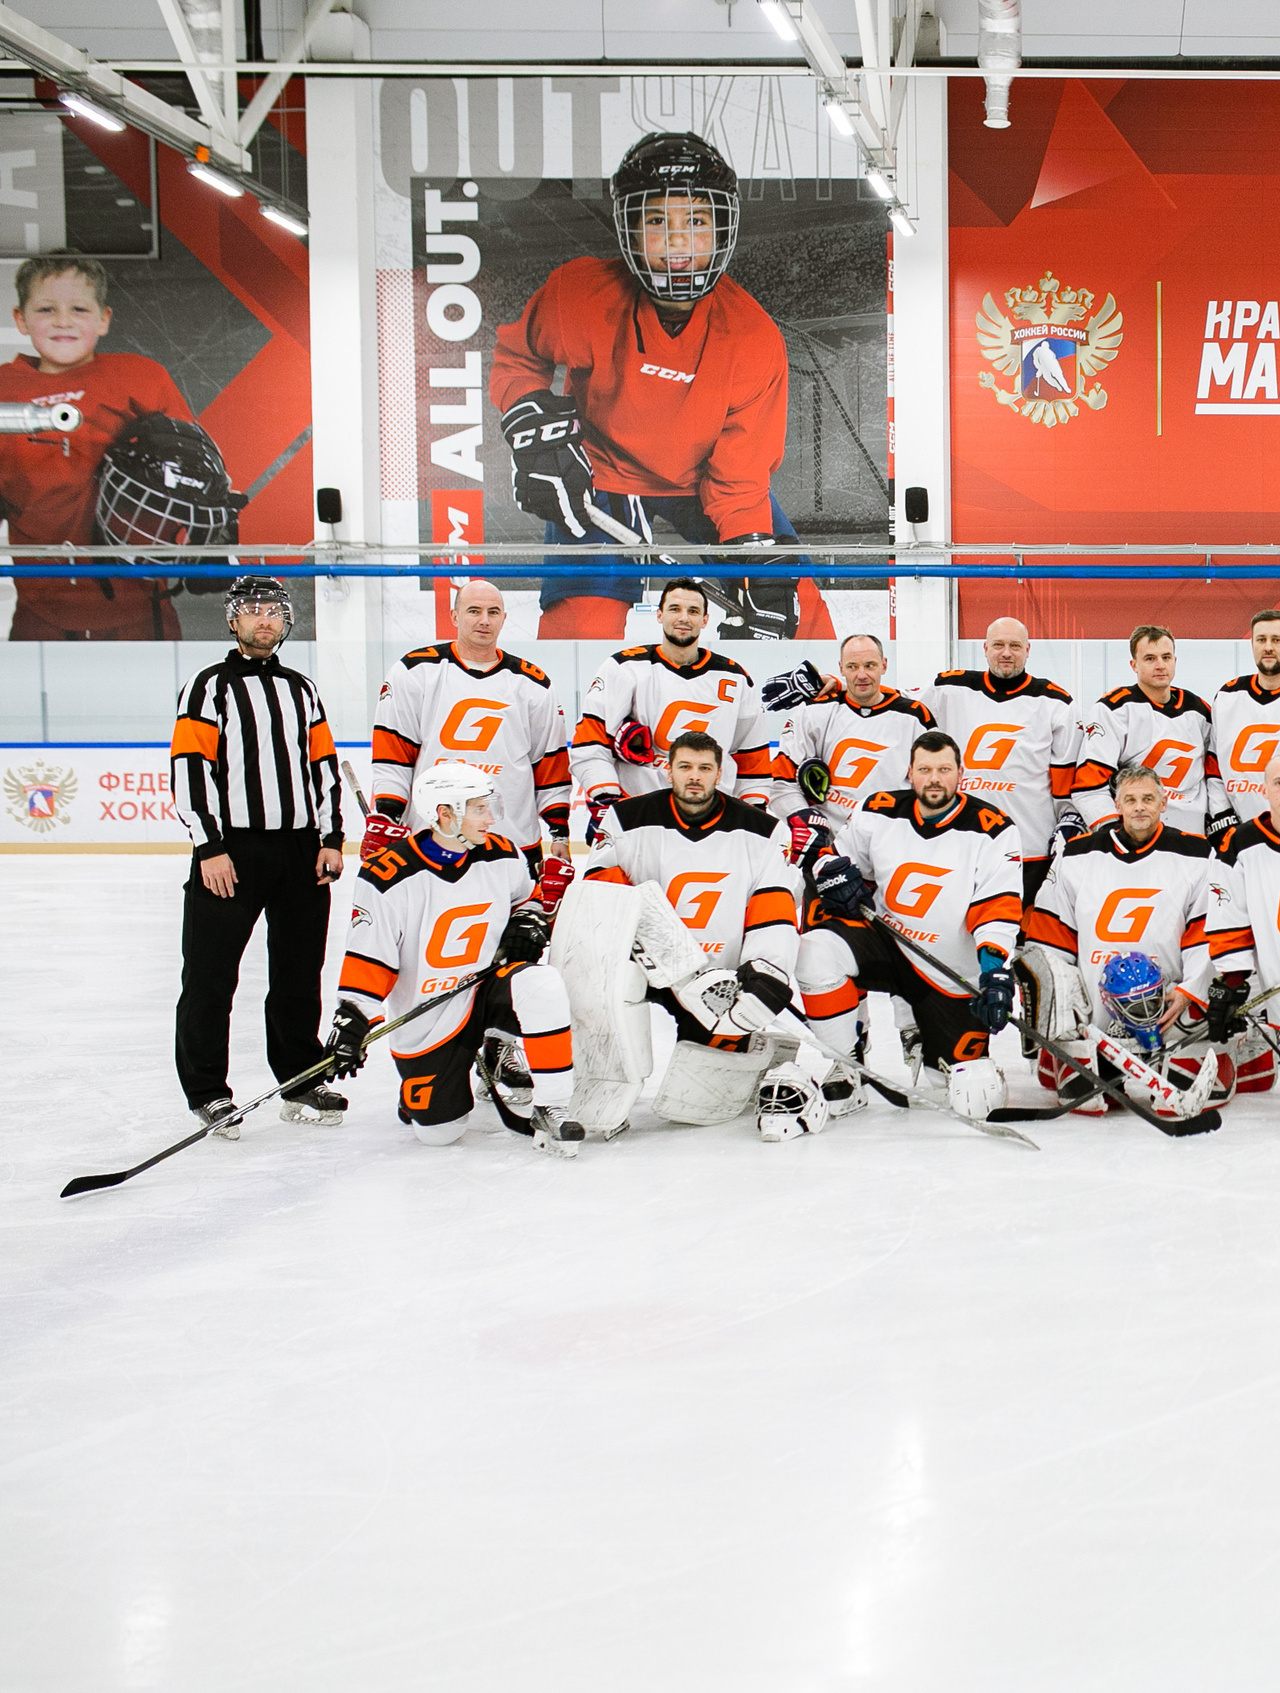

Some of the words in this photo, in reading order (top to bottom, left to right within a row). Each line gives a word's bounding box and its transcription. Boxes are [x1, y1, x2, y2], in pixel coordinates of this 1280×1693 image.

[658, 164, 696, 175] CCM
[425, 180, 484, 341] OUT.
[887, 259, 895, 292] CCM
[1013, 324, 1048, 341] ХОККЕЙ
[1050, 326, 1087, 342] РОССИИ
[639, 362, 696, 384] CCM
[428, 350, 484, 482] ALL
[888, 421, 896, 454] CCM
[717, 678, 738, 703] C
[99, 770, 169, 793] ФЕДЕ
[99, 801, 177, 821] ХОКК
[1097, 1039, 1174, 1100] CCM
